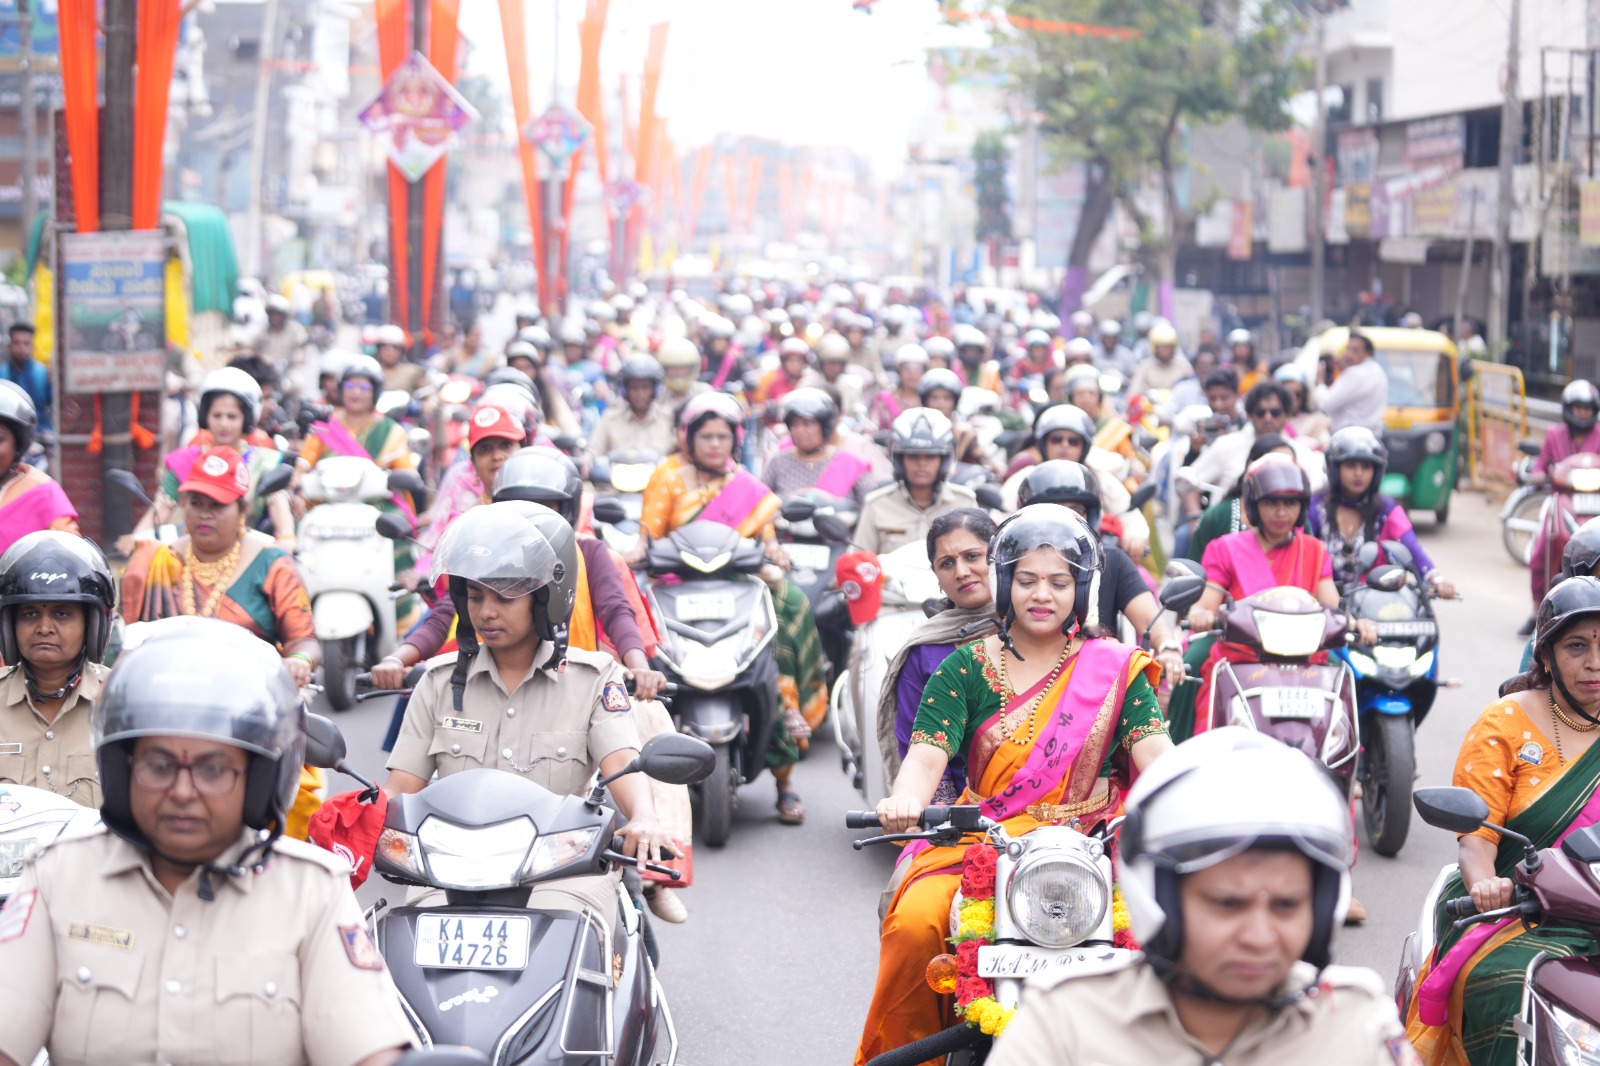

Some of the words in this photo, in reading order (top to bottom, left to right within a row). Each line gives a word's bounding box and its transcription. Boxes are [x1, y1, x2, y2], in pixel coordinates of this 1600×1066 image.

[439, 918, 464, 941] KA
[482, 920, 508, 942] 44
[438, 943, 508, 966] V4726
